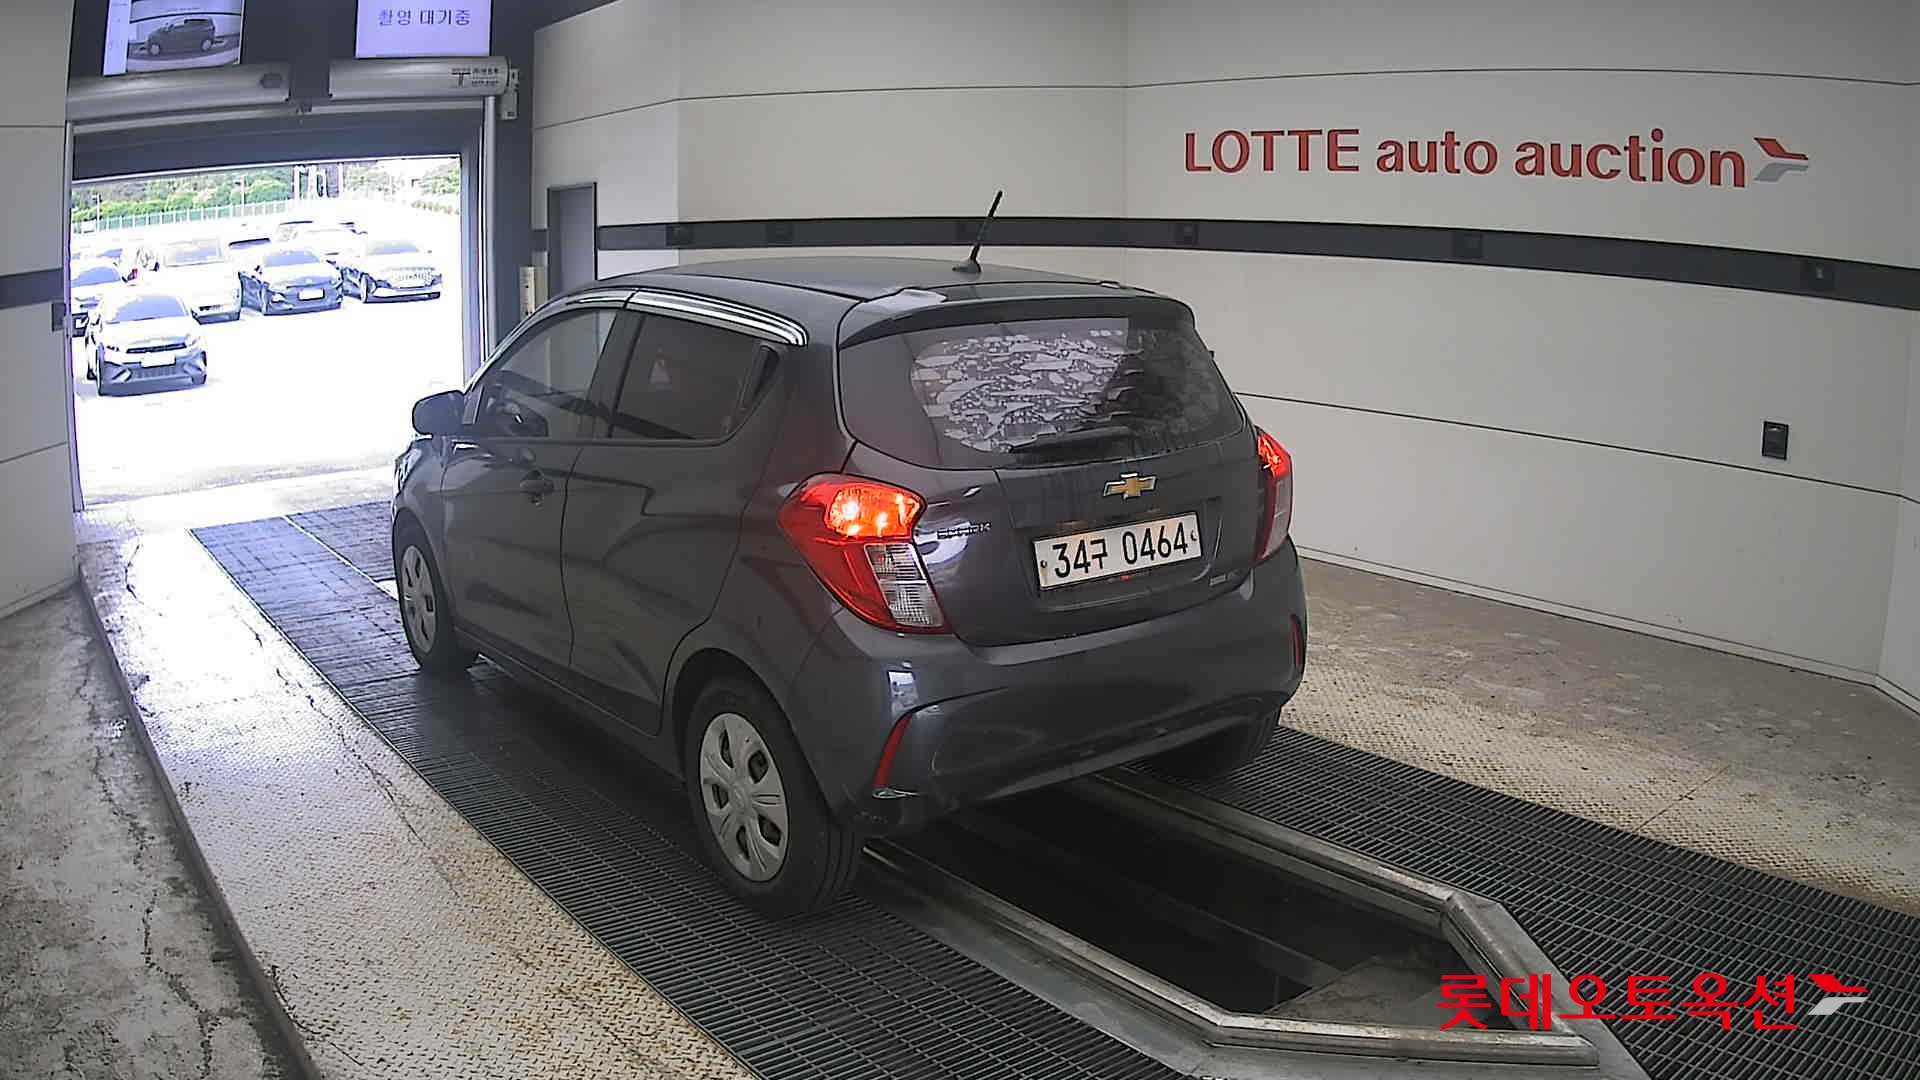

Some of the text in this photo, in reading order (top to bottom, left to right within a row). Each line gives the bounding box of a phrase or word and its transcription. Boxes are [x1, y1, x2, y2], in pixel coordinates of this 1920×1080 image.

[420, 9, 470, 26] 대기중
[1186, 129, 1745, 188] LOTTE auto auction
[1052, 522, 1189, 578] 34구 0464
